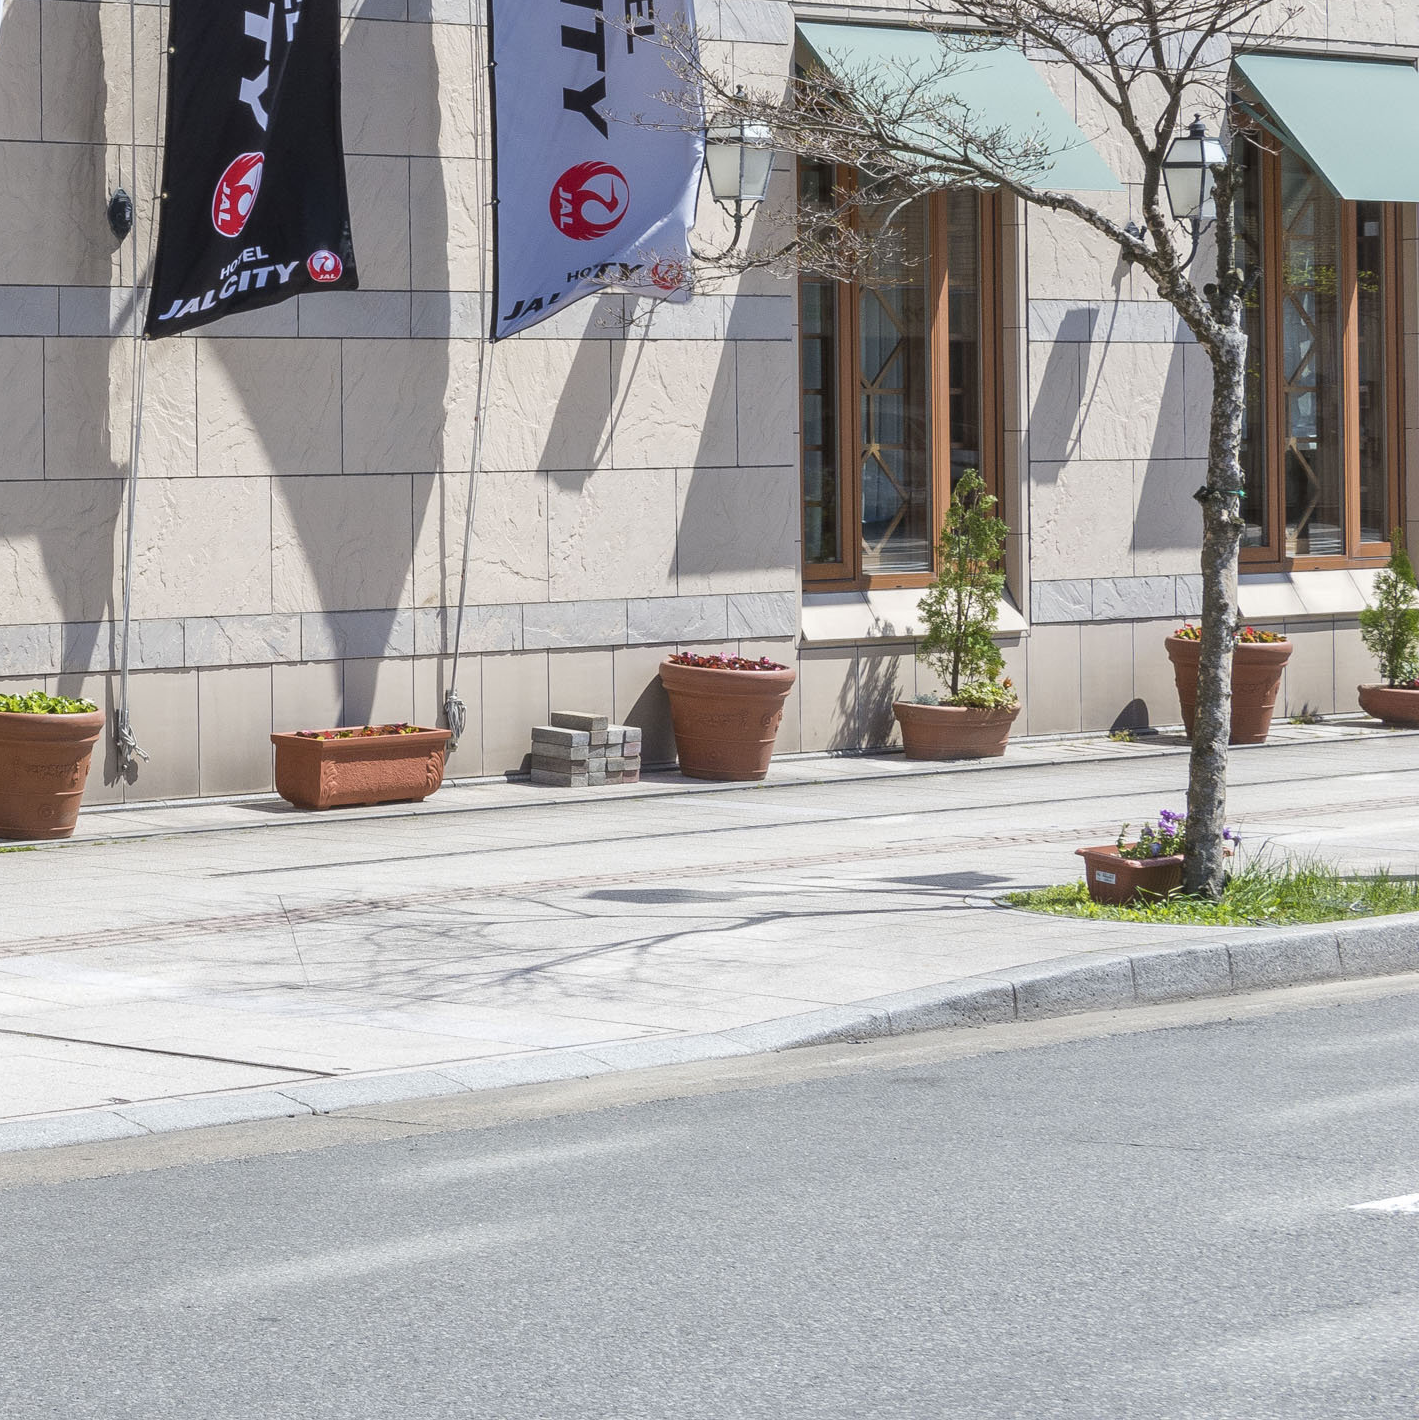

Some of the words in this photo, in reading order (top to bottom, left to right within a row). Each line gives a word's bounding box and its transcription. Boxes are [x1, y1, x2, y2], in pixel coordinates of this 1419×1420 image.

[217, 181, 231, 226] JAL
[558, 186, 573, 229] JAL
[220, 245, 269, 280] HOTEL
[158, 289, 217, 320] JAL
[219, 260, 300, 300] CITY
